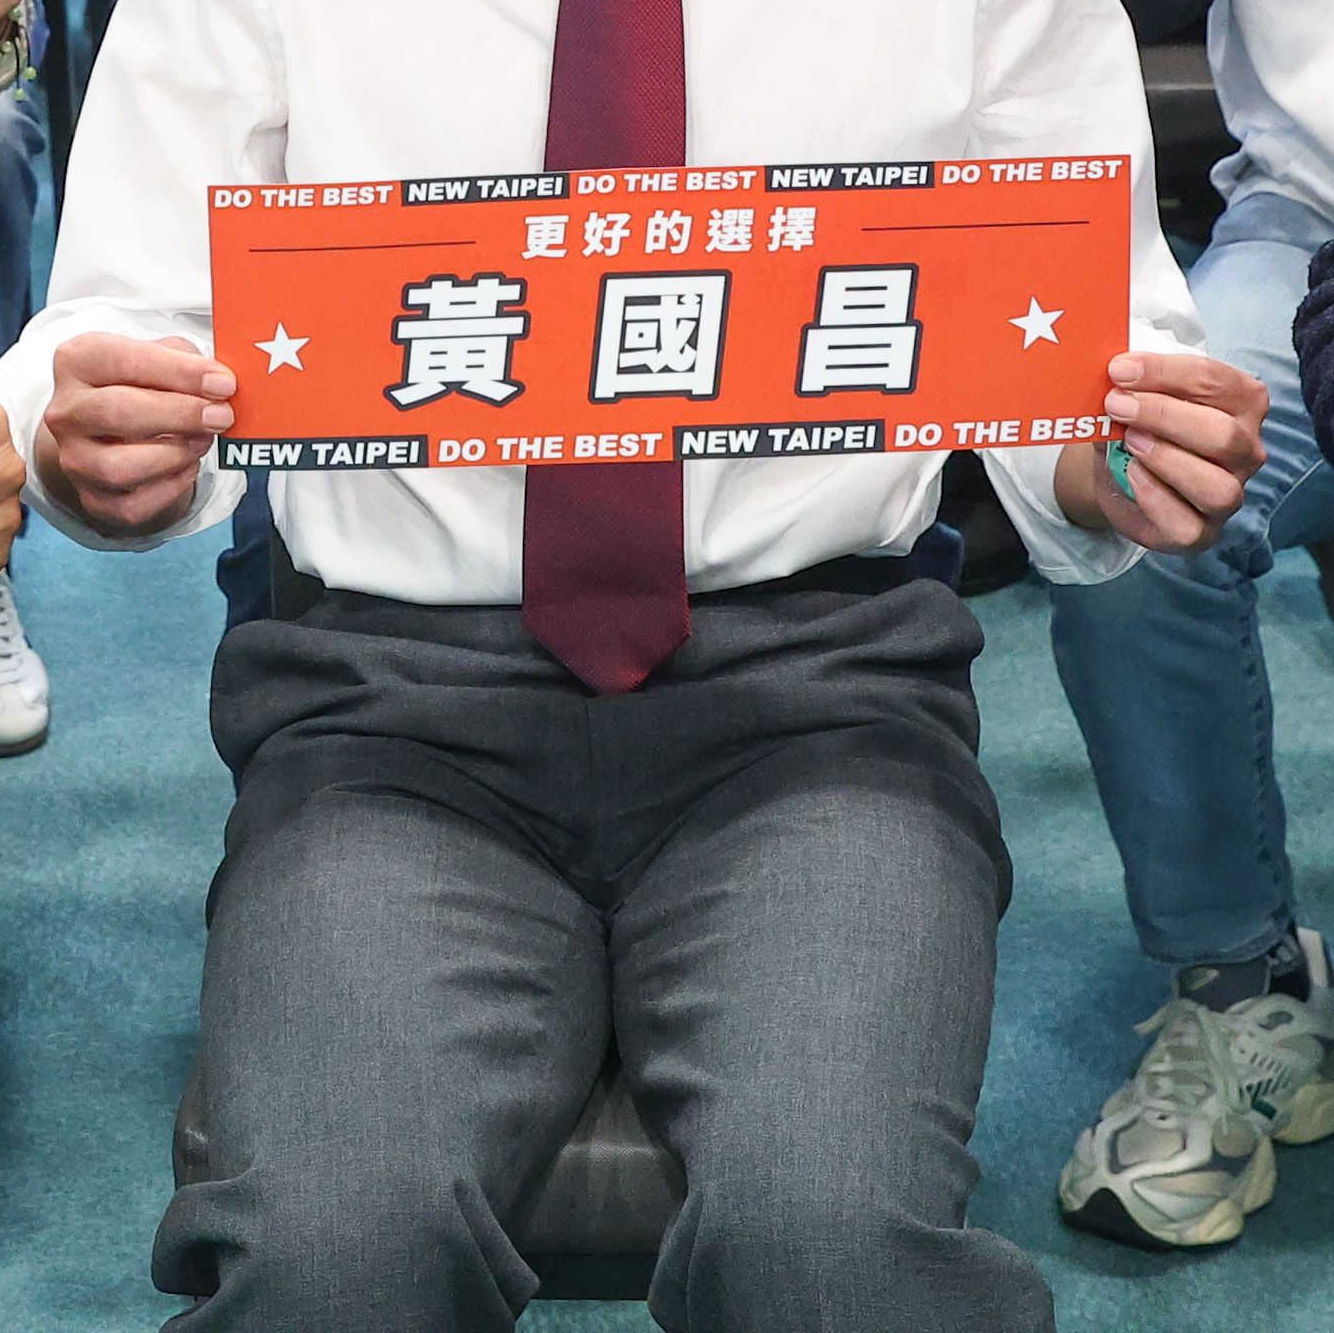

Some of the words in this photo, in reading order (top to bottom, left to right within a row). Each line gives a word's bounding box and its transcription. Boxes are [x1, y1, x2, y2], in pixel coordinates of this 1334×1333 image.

[214, 189, 252, 208] DO
[260, 188, 315, 207] THE
[322, 185, 394, 206] BEST
[408, 180, 470, 202] NEW
[476, 176, 563, 199] TAIPEI
[578, 174, 616, 194] DO
[624, 172, 678, 192] THE
[686, 170, 757, 191] BEST
[771, 168, 834, 188] NEW
[840, 166, 928, 186] TAIPEI
[942, 164, 981, 184] DO
[989, 162, 1043, 182] THE
[1050, 160, 1123, 180] BEST
[521, 207, 817, 259] 更好的選擇
[385, 265, 921, 409] 黃國昌
[226, 443, 303, 466] NEW
[311, 440, 420, 465] TAIPEI
[438, 438, 486, 462] DO
[496, 436, 564, 460] THE
[574, 433, 663, 458] BEST
[681, 429, 760, 455] NEW
[768, 425, 876, 452] TAIPEI
[895, 423, 943, 447] DO
[953, 420, 1021, 445] THE
[1030, 415, 1113, 442] BEST
